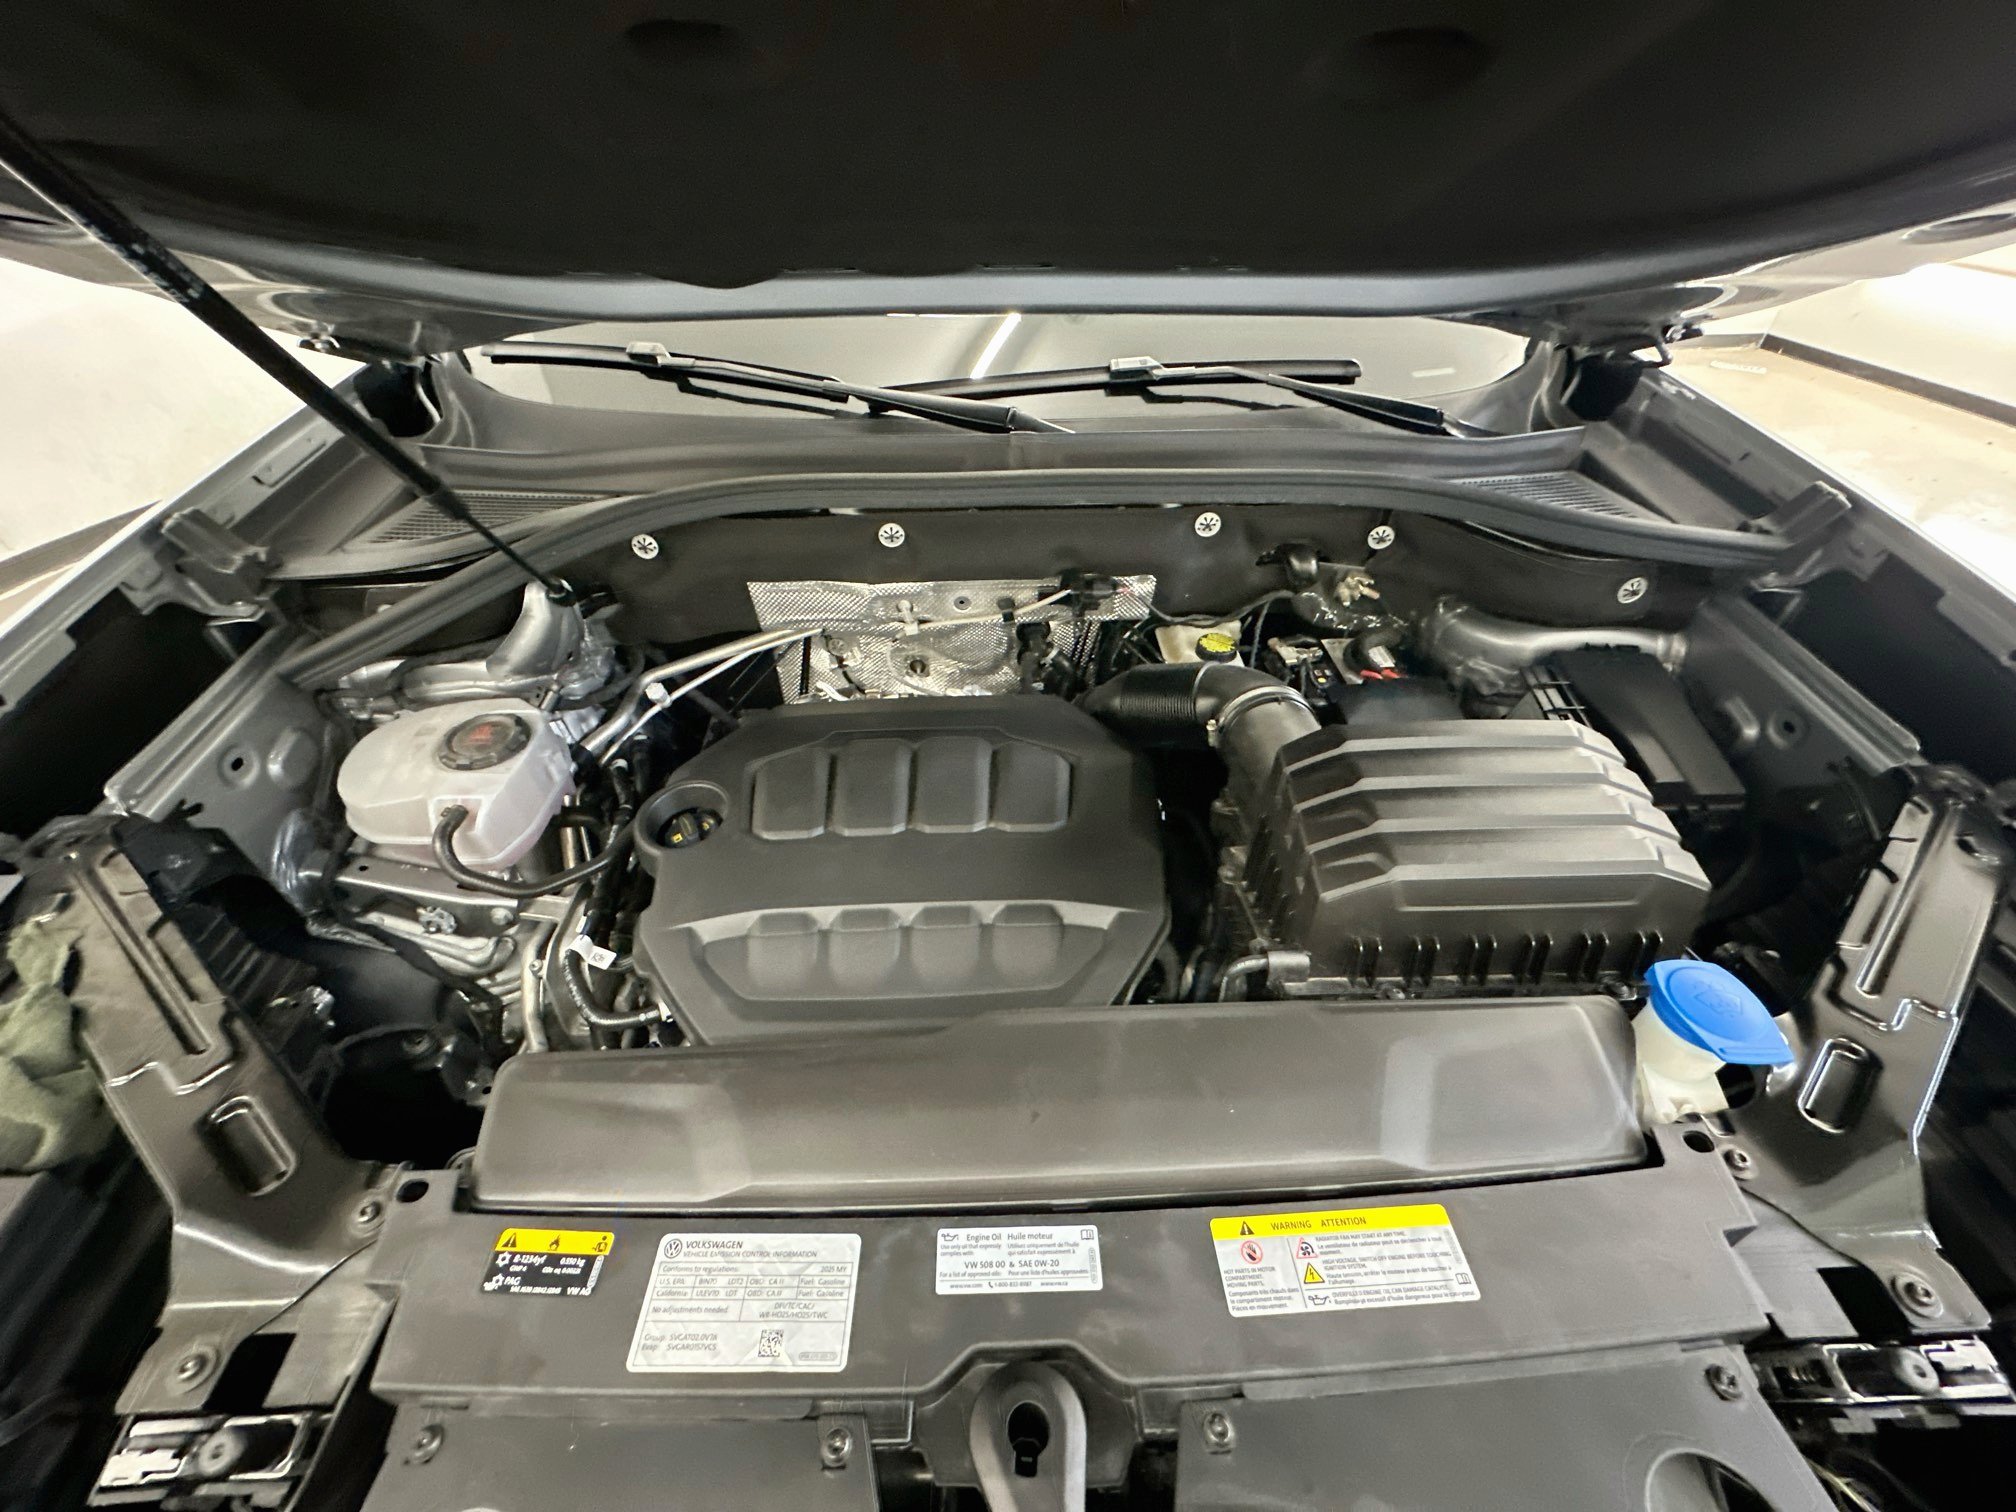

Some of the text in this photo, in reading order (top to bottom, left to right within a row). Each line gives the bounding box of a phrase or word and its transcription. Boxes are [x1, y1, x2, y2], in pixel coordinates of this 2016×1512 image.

[1271, 1217, 1366, 1230] WARNING ATTENTION
[967, 1233, 990, 1243] Engine
[686, 1240, 743, 1249] VOLKSWAGEN
[513, 1254, 548, 1266] R-1234yf
[576, 1258, 586, 1267] kg
[964, 1261, 978, 1269] VW
[995, 1260, 1006, 1268] 00
[1019, 1260, 1033, 1268] SAE
[504, 1276, 521, 1285] PAG
[567, 1287, 580, 1295] VW
[662, 1305, 702, 1315] adjustments
